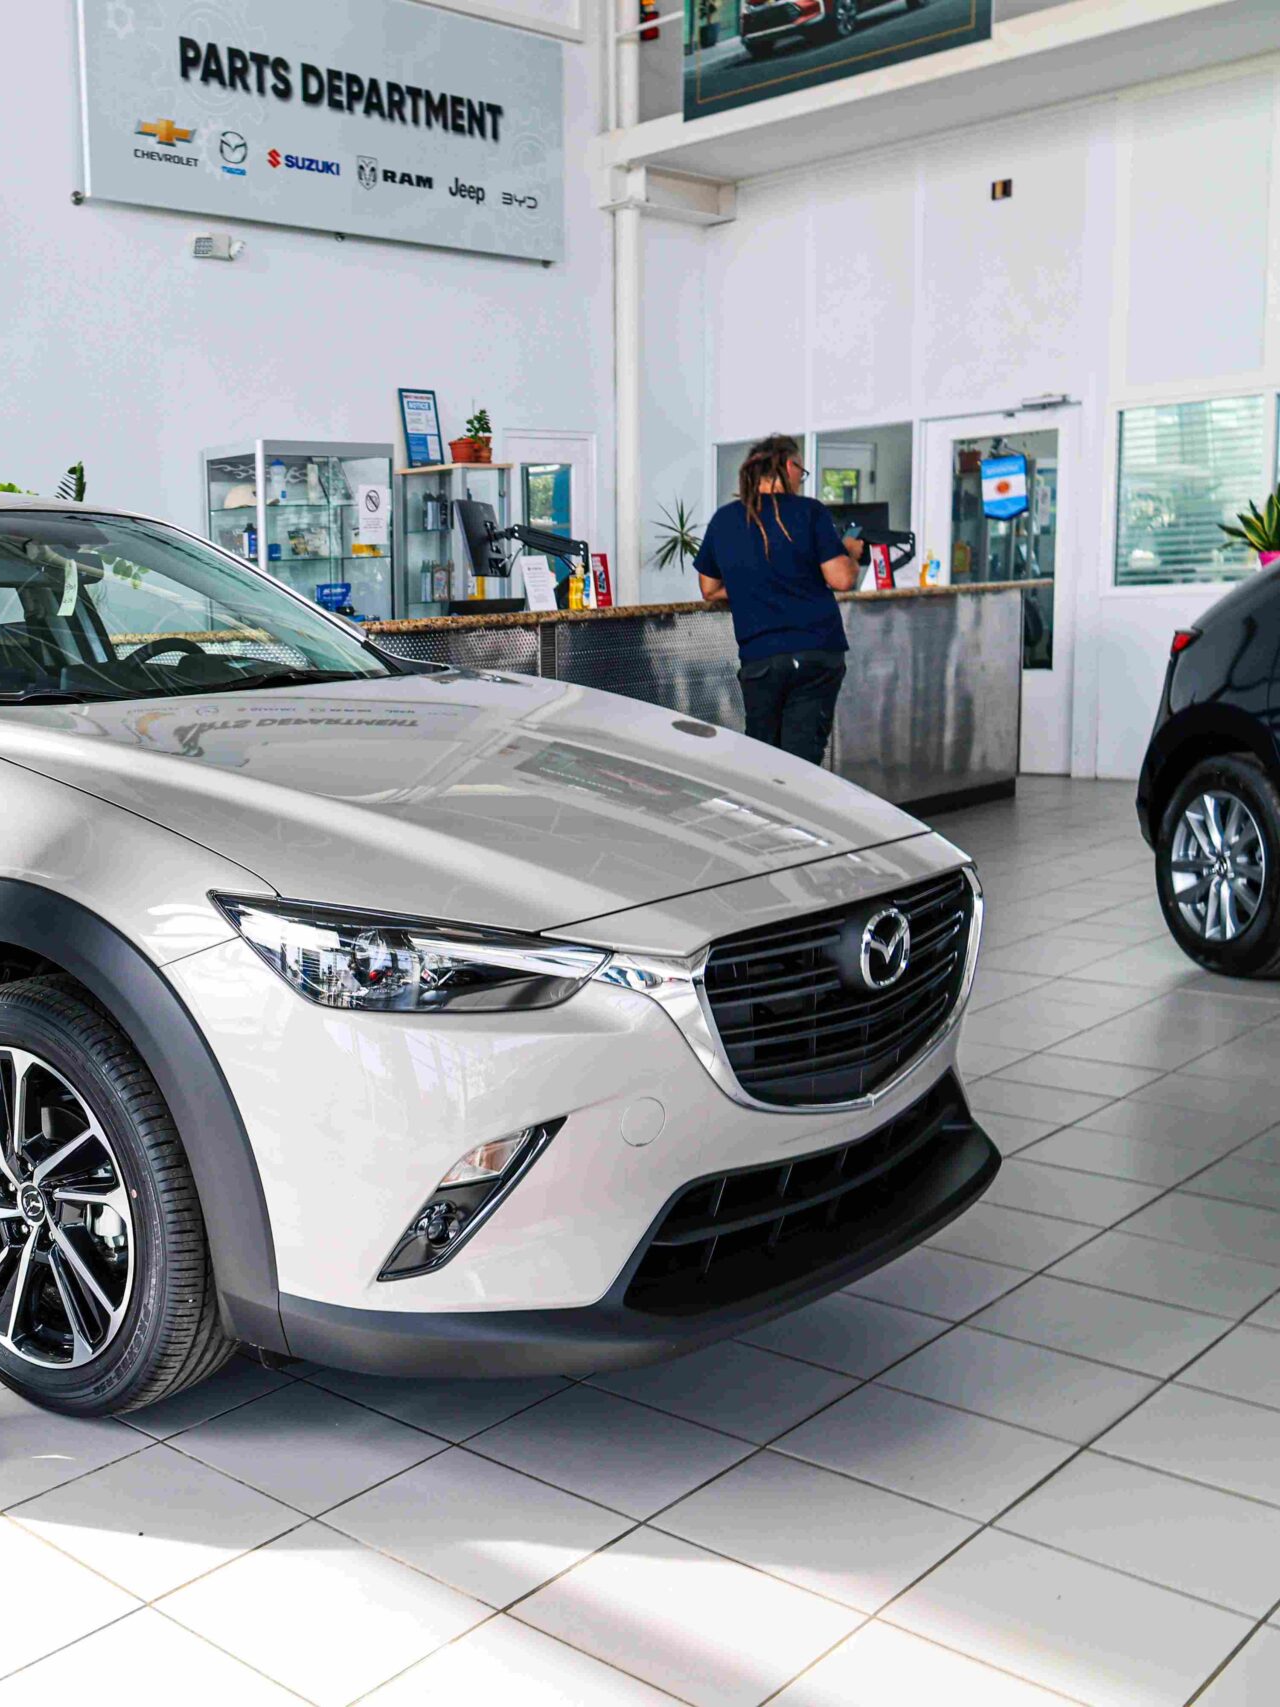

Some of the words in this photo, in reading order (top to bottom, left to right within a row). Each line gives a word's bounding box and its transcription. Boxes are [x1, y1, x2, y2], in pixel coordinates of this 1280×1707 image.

[179, 36, 292, 101] PARTS
[301, 62, 503, 141] DEPARTMENT
[133, 148, 199, 168] CHEVROLET
[284, 154, 341, 176] SUZUKI
[382, 169, 434, 189] RAM
[448, 177, 486, 204] Jeep
